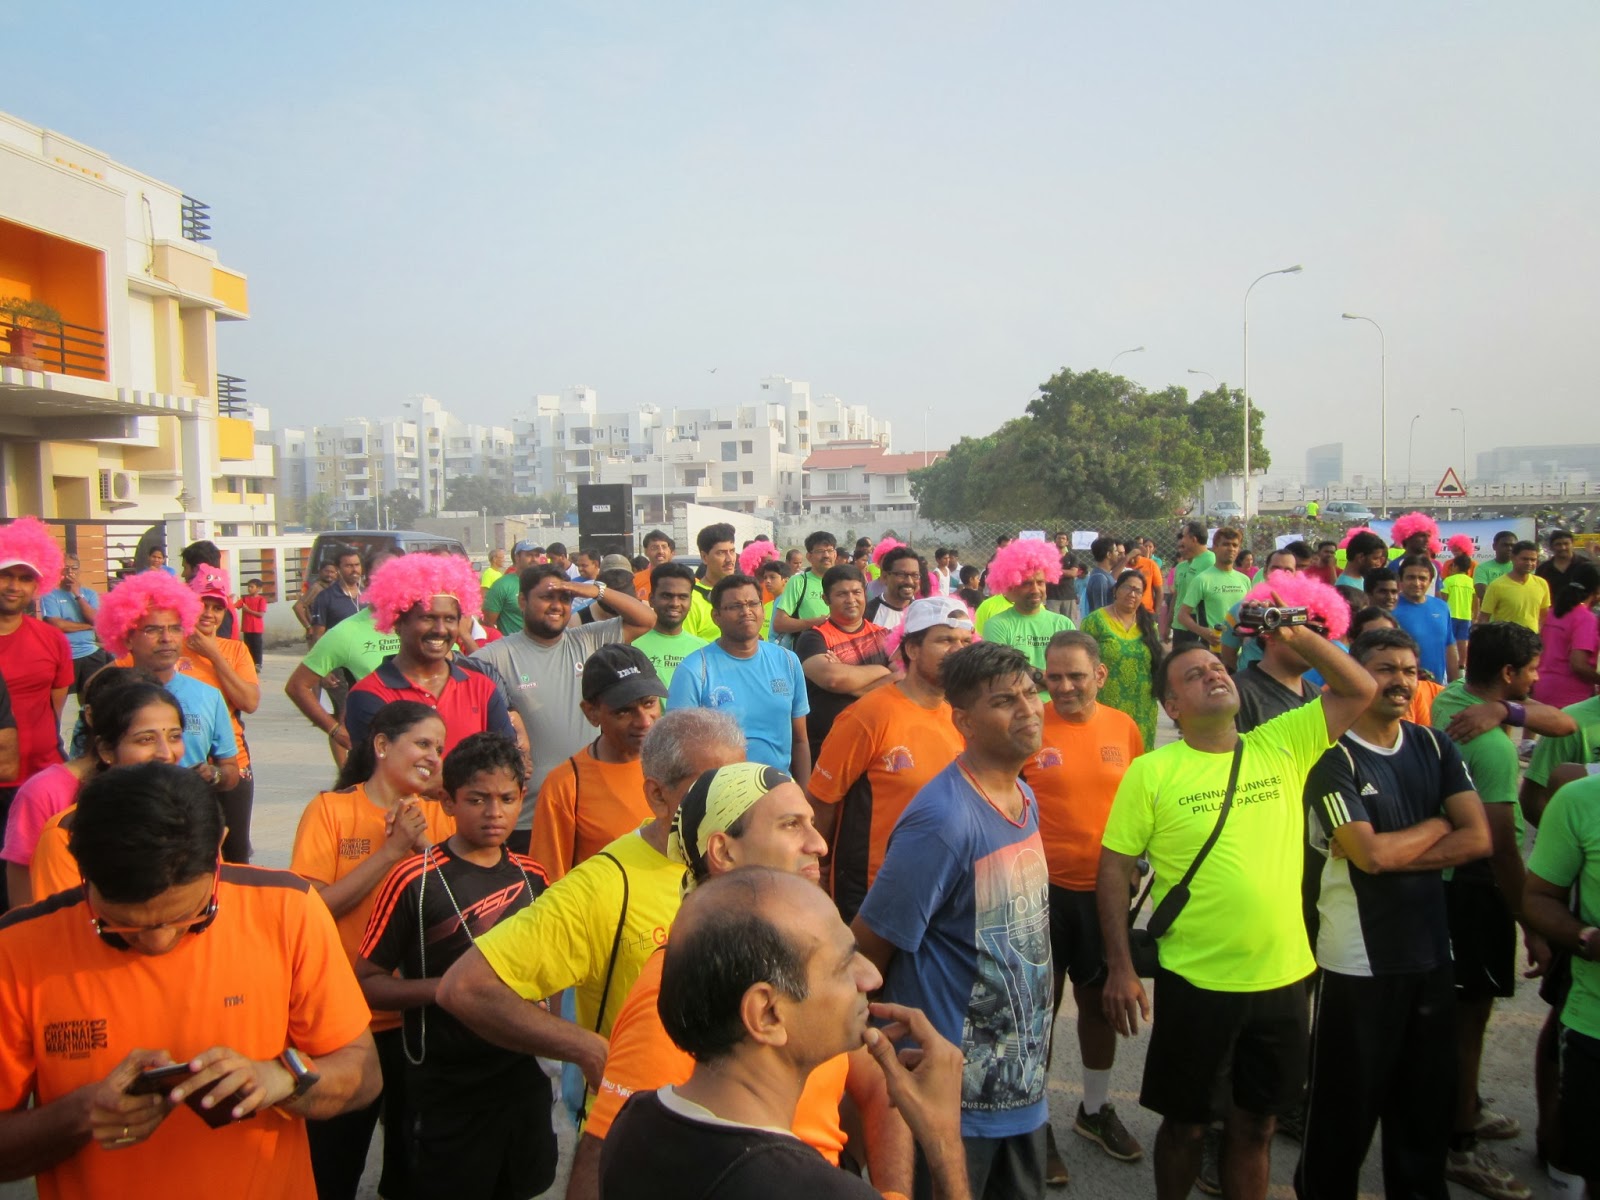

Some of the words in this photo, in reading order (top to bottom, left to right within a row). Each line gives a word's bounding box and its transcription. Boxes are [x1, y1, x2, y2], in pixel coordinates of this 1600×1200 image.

[617, 666, 641, 678] IBM
[1178, 789, 1228, 806] CHENNA
[1236, 789, 1281, 807] PACERS
[361, 838, 371, 855] 2013
[1007, 883, 1049, 918] TOKYO
[44, 1027, 91, 1042] CHENNAI
[91, 1019, 108, 1050] 2013
[46, 1040, 91, 1053] MARATHON
